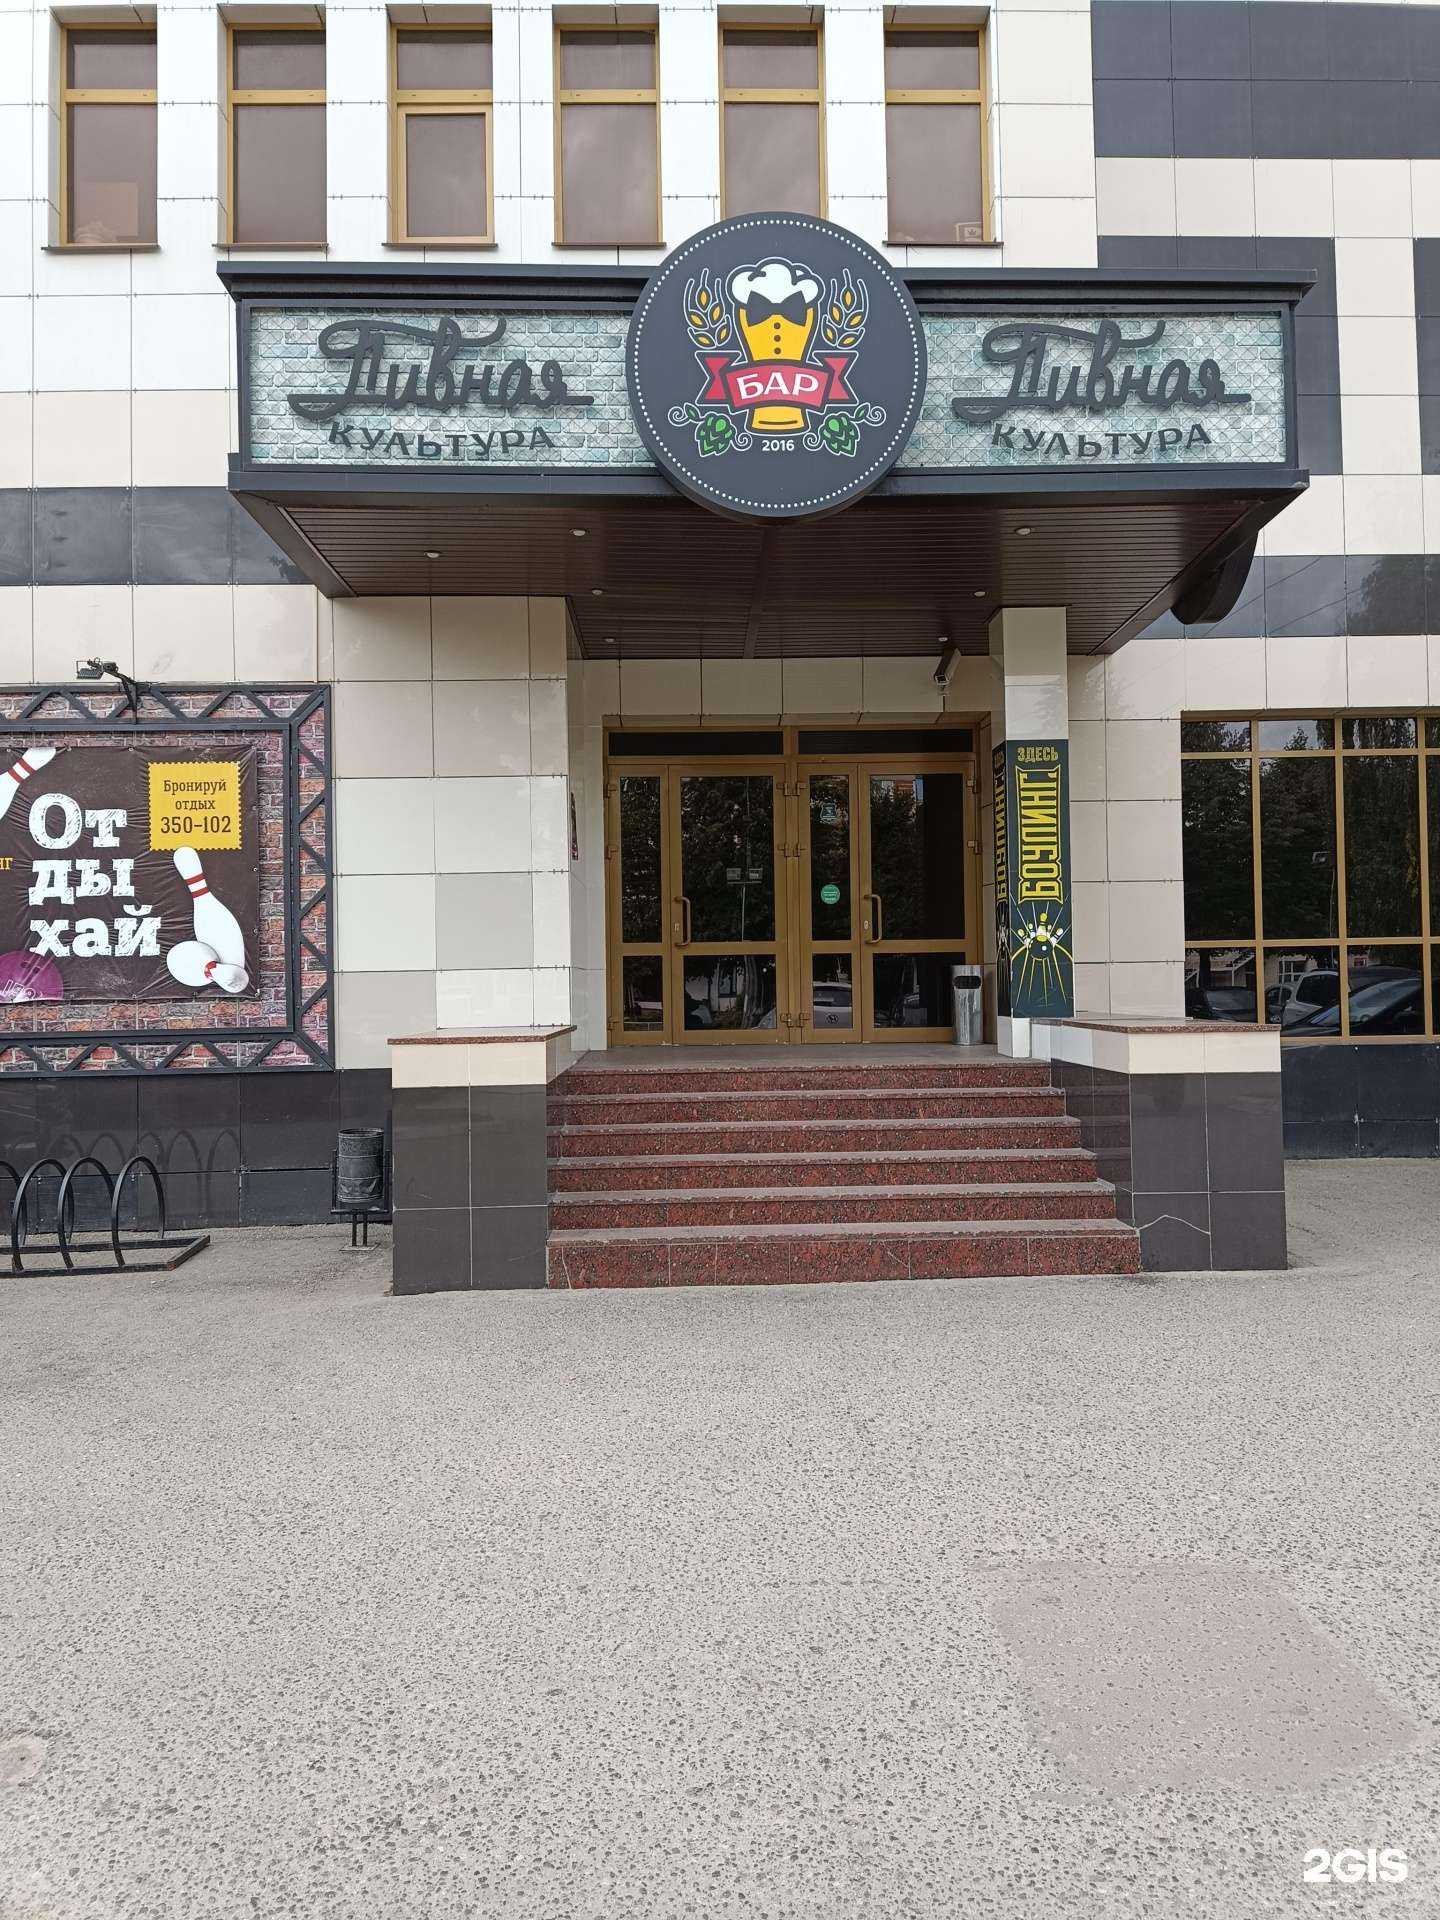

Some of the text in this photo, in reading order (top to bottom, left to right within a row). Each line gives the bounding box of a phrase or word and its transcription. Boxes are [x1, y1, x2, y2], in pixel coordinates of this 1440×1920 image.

[287, 317, 594, 419] Пивная
[952, 319, 1251, 422] Пивная
[736, 371, 819, 400] БАР
[328, 421, 556, 457] КУЛЬТУРА
[761, 439, 795, 452] 2016
[991, 423, 1212, 457] КУЛЬТУРА
[1017, 745, 1058, 763] ЗДЕСЬ
[163, 779, 227, 796] Бронируй
[28, 793, 128, 850] От
[175, 800, 216, 811] отдых
[161, 815, 232, 834] 350-102
[28, 858, 136, 906] ды
[29, 904, 162, 958] хай
